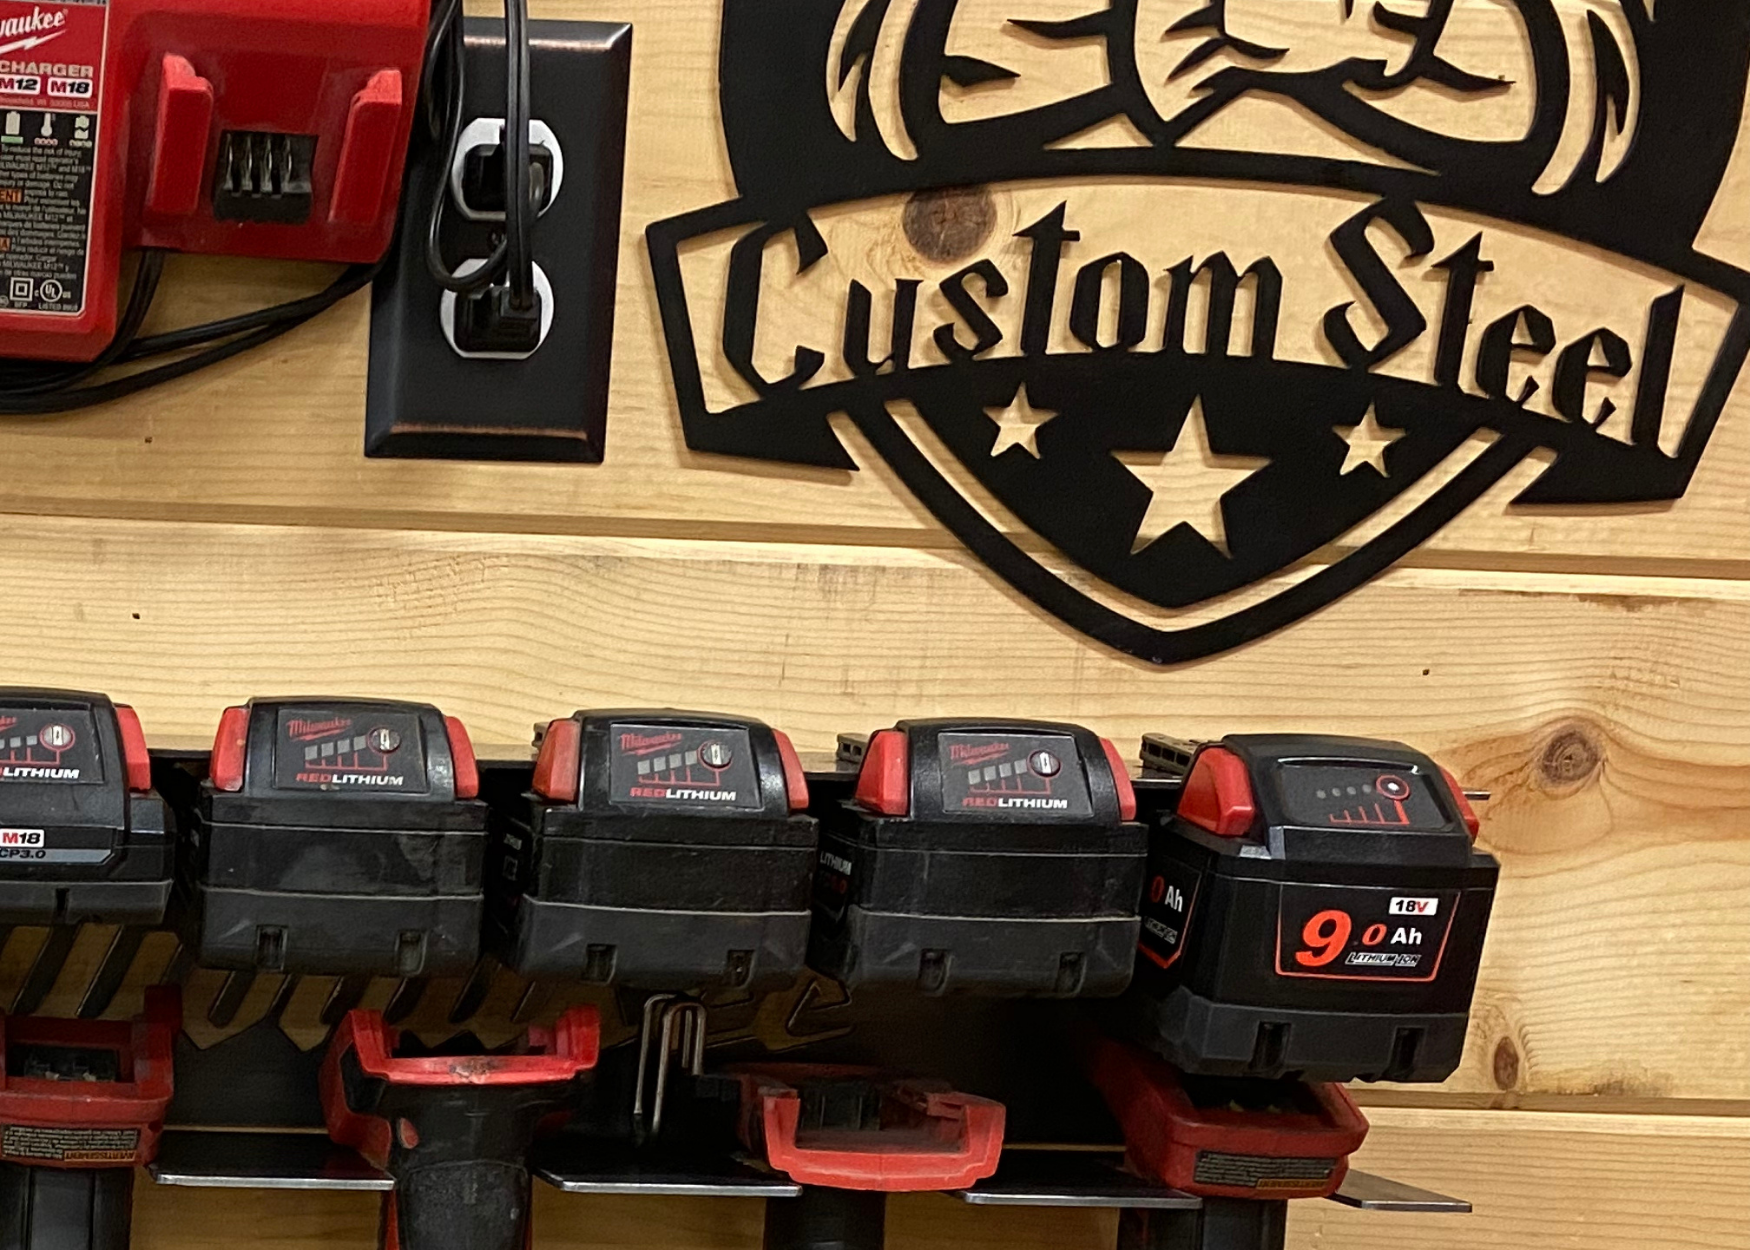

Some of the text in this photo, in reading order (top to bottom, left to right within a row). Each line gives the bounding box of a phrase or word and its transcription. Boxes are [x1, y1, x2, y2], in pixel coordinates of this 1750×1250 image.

[50, 80, 91, 94] M18
[724, 199, 1684, 447] Custom Steel
[296, 772, 404, 786] REDLITHIUM
[629, 787, 737, 801] REDLITHIUM
[962, 797, 1068, 809] REDLITHIUM
[1, 831, 42, 845] M18
[1164, 885, 1183, 913] Ah
[1395, 900, 1430, 913] 18V
[1295, 909, 1422, 967] 9.0 Ah
